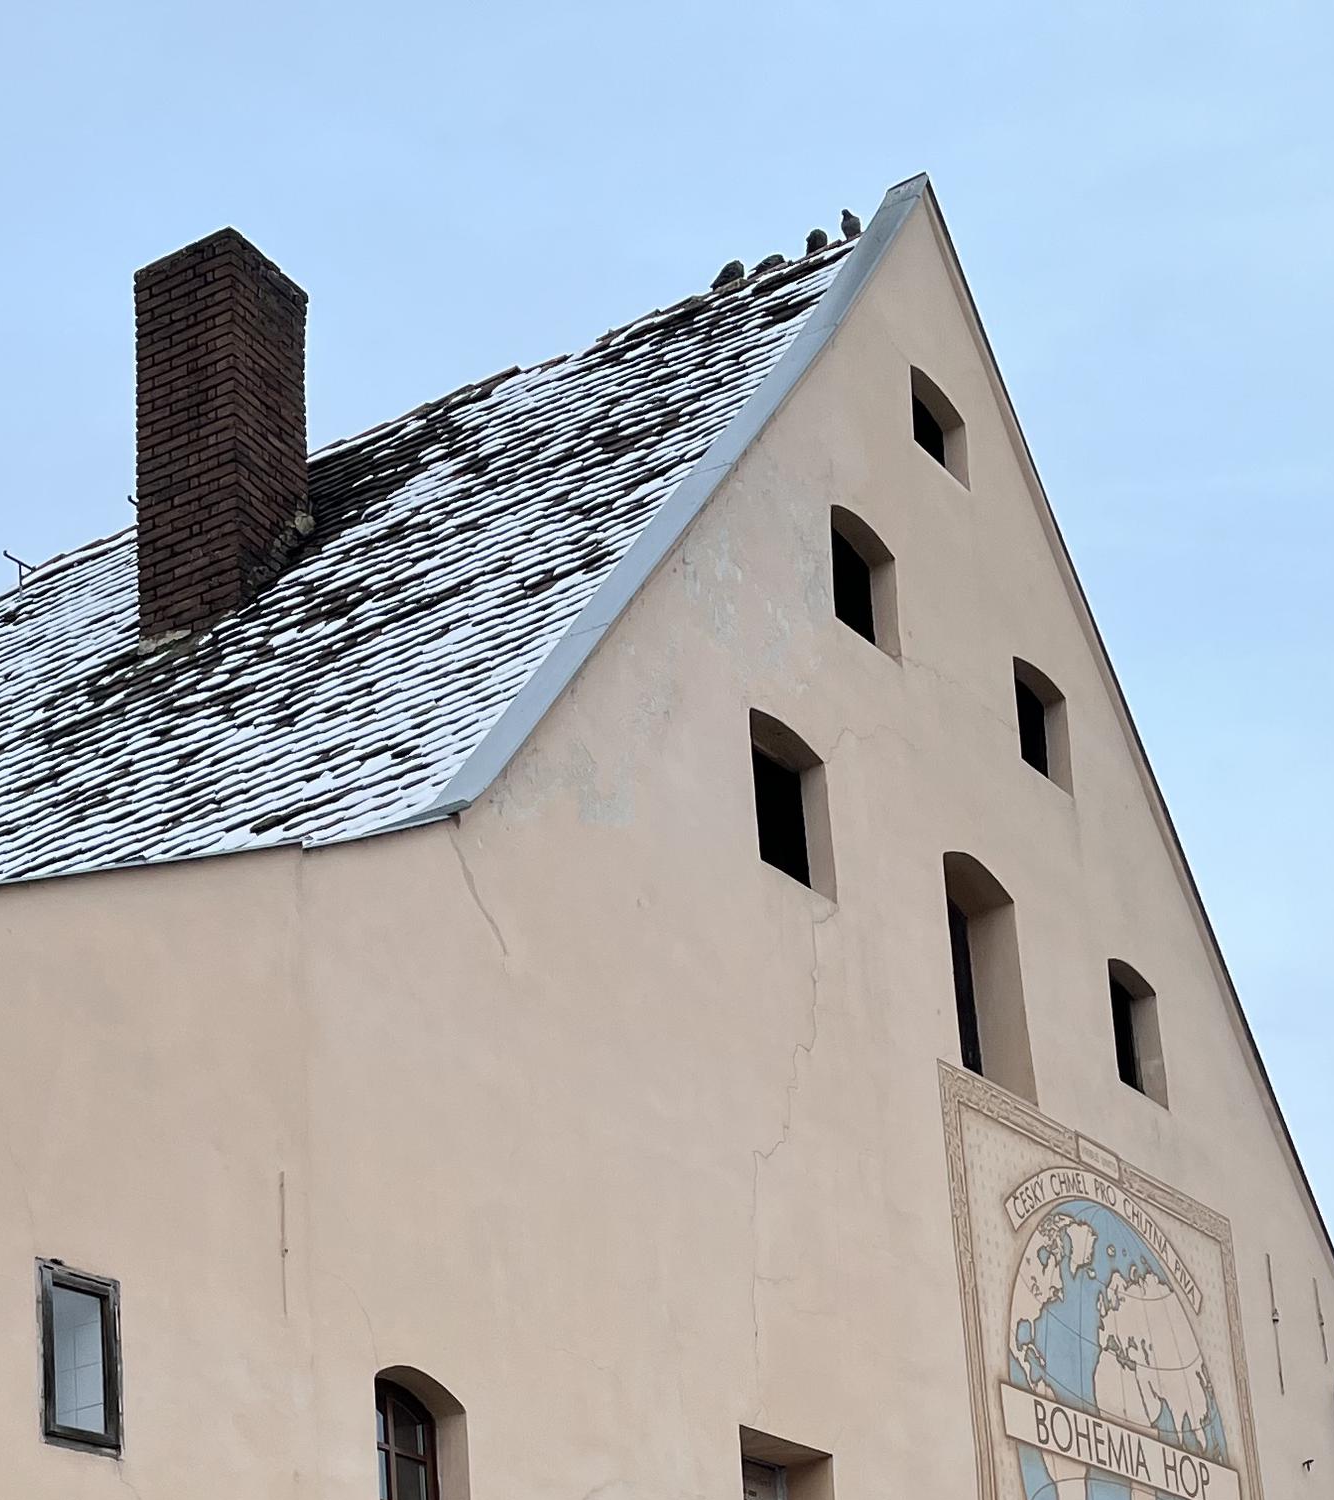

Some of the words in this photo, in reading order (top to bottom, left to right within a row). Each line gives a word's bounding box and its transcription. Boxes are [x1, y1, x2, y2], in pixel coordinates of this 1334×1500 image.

[1012, 1175, 1045, 1220] ČESKÝ
[1050, 1172, 1089, 1197] CHMEL
[1094, 1178, 1117, 1206] PRO
[1174, 1259, 1196, 1305] PIVA
[1033, 1399, 1151, 1482] BOHEMIA
